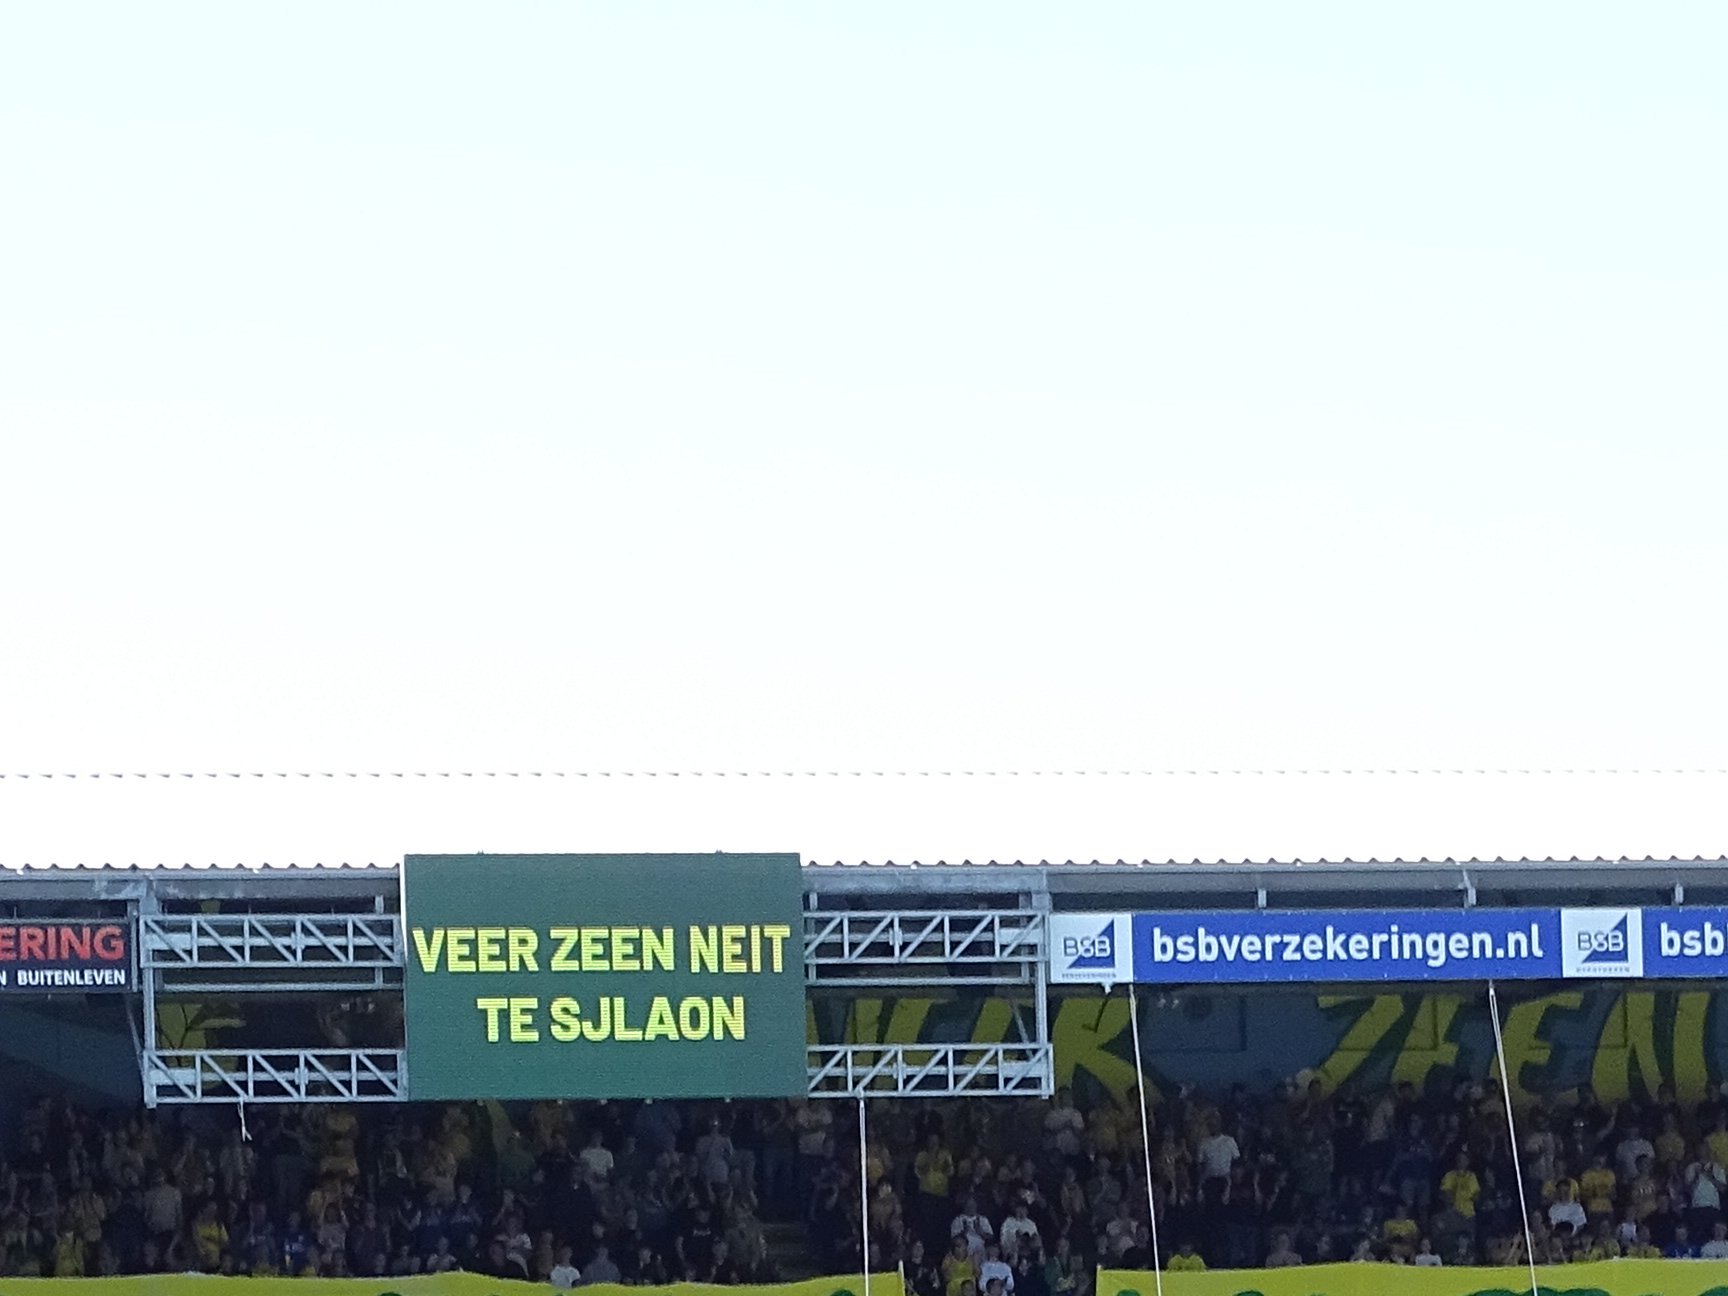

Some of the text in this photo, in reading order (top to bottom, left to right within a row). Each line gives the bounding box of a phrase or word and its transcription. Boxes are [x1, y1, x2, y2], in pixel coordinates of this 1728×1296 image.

[412, 924, 791, 973] VEER ZEEN NEIT
[1063, 936, 1111, 957] BSB
[1153, 923, 1544, 969] bsbverzekeringen.nl
[1578, 931, 1624, 952] BSB
[17, 968, 126, 986] BUITENLEVEN
[476, 996, 746, 1043] TE SJLAON
